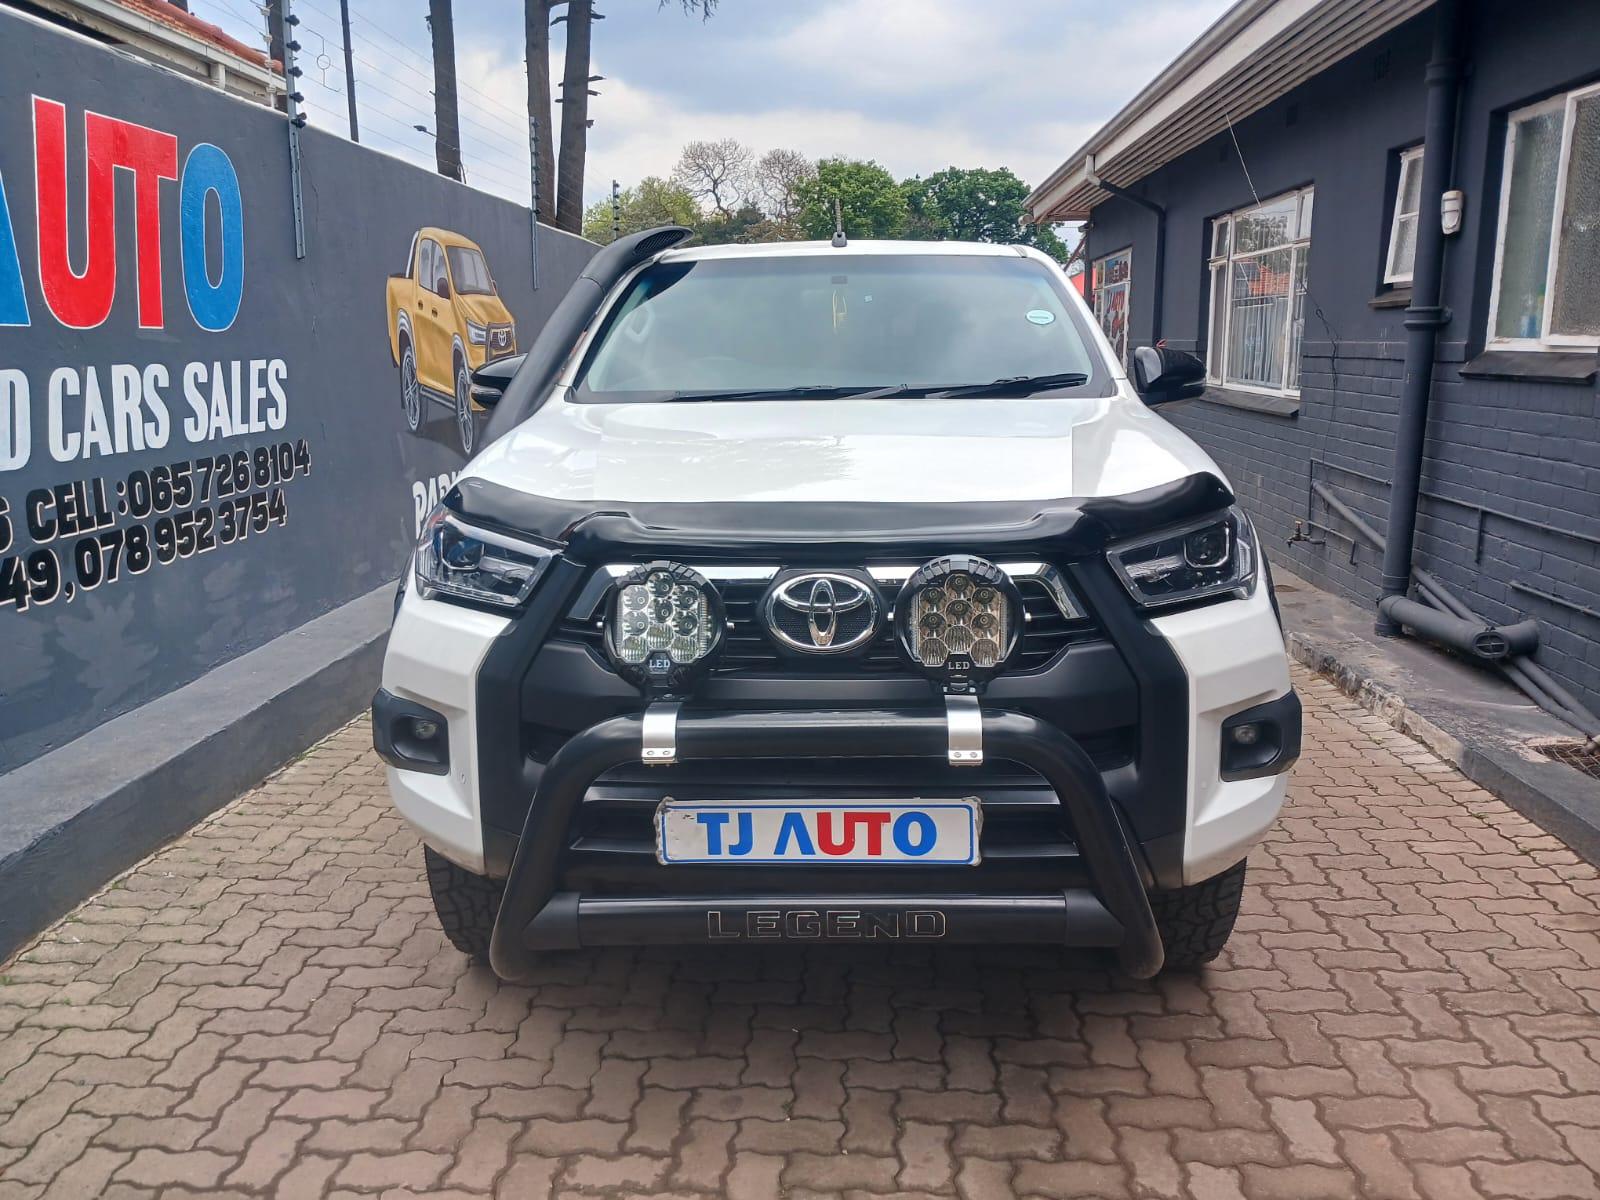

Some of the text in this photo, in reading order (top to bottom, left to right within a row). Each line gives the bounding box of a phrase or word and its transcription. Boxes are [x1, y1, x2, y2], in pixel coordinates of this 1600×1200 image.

[48, 363, 170, 462] CARS
[183, 359, 288, 443] SALES
[196, 450, 251, 503] 726
[253, 439, 312, 488] 8104
[154, 510, 217, 565] 952
[218, 487, 288, 544] 3754
[649, 659, 671, 668] LED
[948, 661, 970, 670] LED
[697, 811, 938, 857] TJ AUTO
[707, 910, 946, 938] LEGEND
